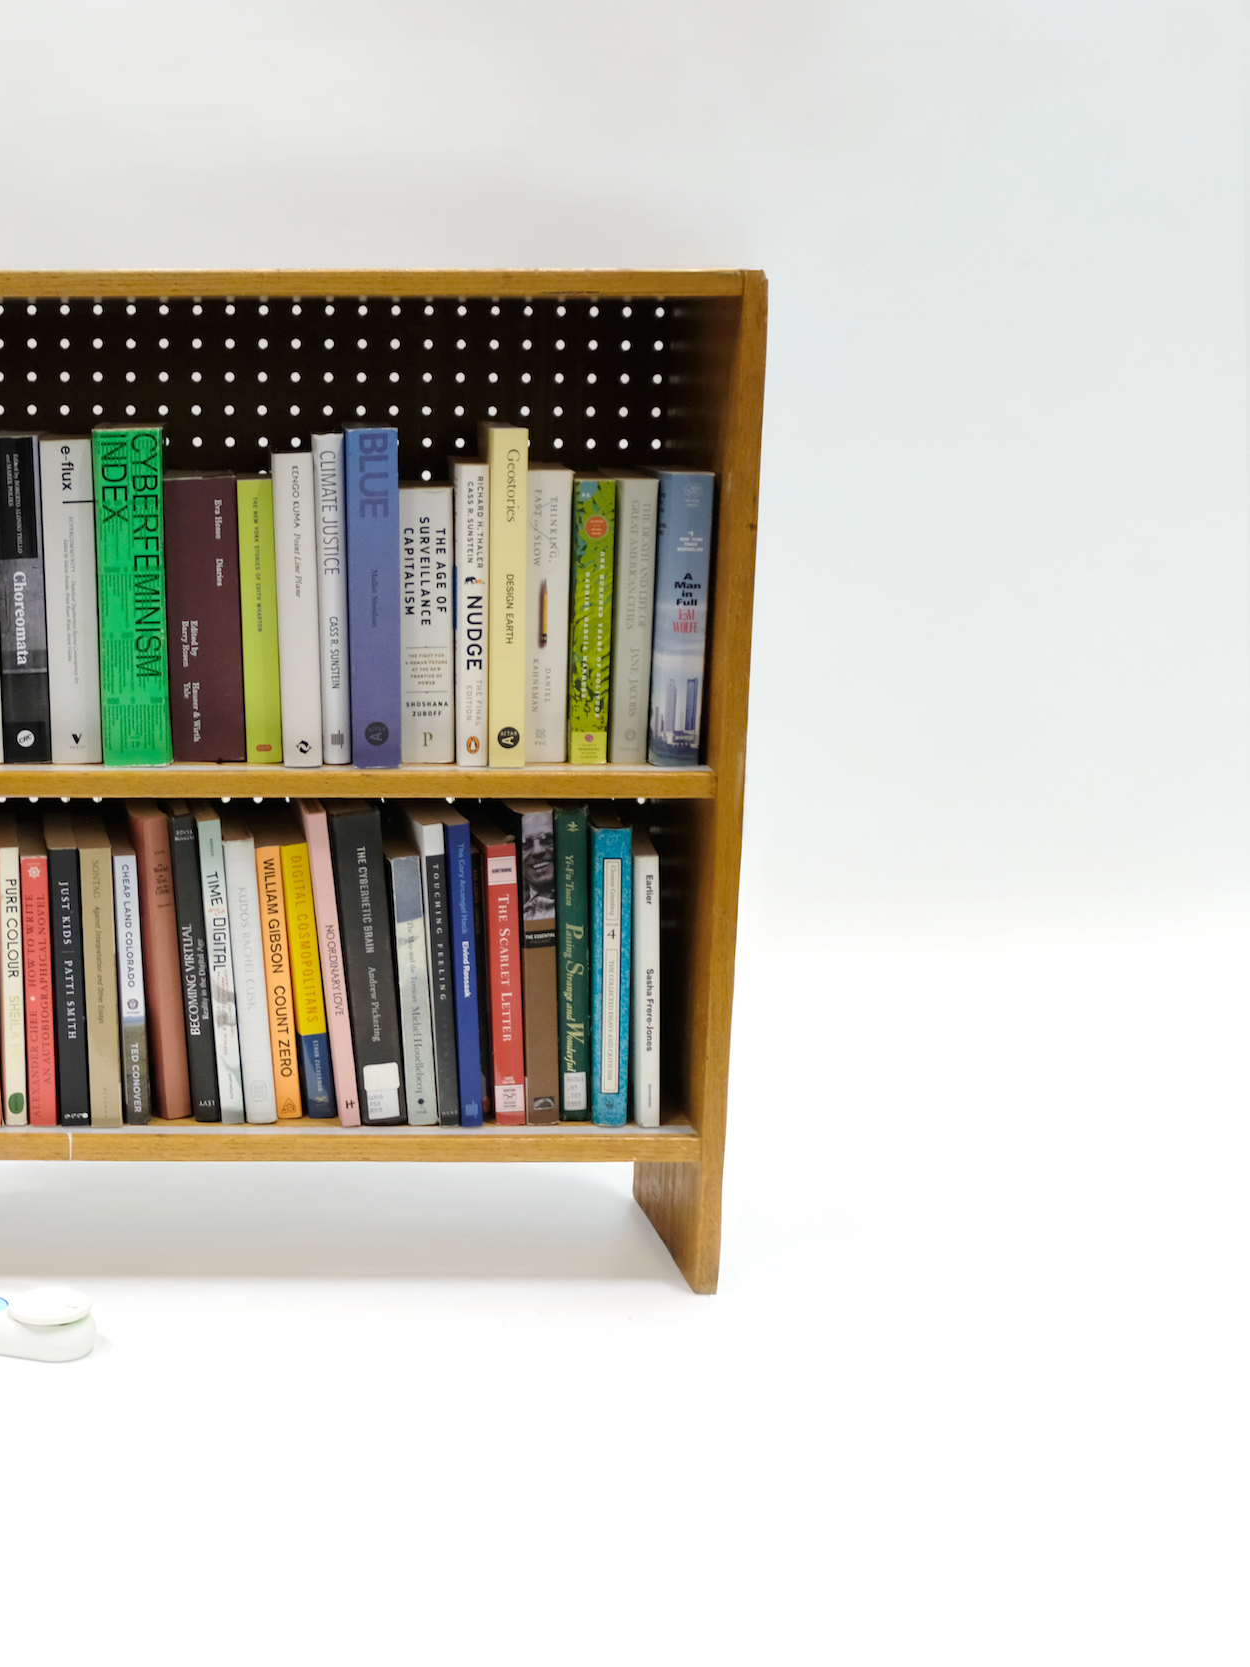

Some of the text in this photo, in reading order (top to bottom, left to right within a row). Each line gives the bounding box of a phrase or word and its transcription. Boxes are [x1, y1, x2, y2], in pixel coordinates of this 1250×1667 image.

[61, 445, 74, 491] e-flux
[100, 433, 128, 524] INDEX
[291, 465, 300, 498] KENGO
[359, 433, 389, 518] BLUE
[506, 448, 520, 523] Geostories
[214, 499, 223, 540] Eva Hesse
[292, 501, 301, 529] KUMA
[293, 533, 301, 554] Point
[319, 450, 340, 575] CLIMATE JUSTICE
[467, 508, 474, 516] R.
[477, 521, 483, 530] H.
[132, 433, 162, 677] CYBERFEMINISM
[215, 558, 224, 586] Diaries
[294, 556, 302, 573] Line
[404, 527, 415, 616] CAPITALISM
[419, 516, 431, 626] SURVEILLANCE
[436, 528, 447, 613] THE AGE OF
[626, 500, 640, 630] GREAT AMERICAN CITIES
[675, 581, 701, 589] Man
[12, 571, 29, 666] Choreomata
[505, 574, 514, 644] DESIGN EARTH
[598, 574, 606, 618] HUNDRED
[676, 598, 698, 606] Full
[181, 620, 190, 667] Barry Rosen
[190, 620, 199, 657] Edited by
[329, 616, 341, 689] CASS R. SUNSTEIN
[466, 596, 483, 670] NUDGE
[596, 657, 602, 668] OF
[183, 682, 191, 699] Yale
[192, 682, 200, 709] Hauser
[531, 658, 539, 713] KAHNEMAN
[594, 673, 602, 718] SOLITUDE
[628, 647, 640, 717] JANE JACOBS
[193, 719, 201, 742] Wirth
[206, 871, 223, 906] TIME
[356, 846, 375, 953] THE CYBERNETIC BRAIN
[458, 859, 466, 877] Cory
[459, 879, 468, 913] Arcangel
[565, 855, 574, 907] Yi-Fu Tuan
[645, 874, 654, 905] Earlier
[5, 879, 19, 978] PURE COLOUR
[58, 881, 77, 1039] JUST KIDS PATTI SMITH
[121, 864, 135, 988] CHEAP LAND COLORADO
[213, 917, 227, 972] DIGITAL
[238, 887, 257, 1010] KUDOS RACHEL CUSK
[291, 855, 318, 1023] DIGITAL COSMOPOLITANS
[433, 863, 447, 1001] TOUCHING FEELING
[37, 894, 51, 1084] AN AUTOBIOGRAPHICAL NOVEL
[181, 923, 201, 1035] BECOMING VIRTUAL
[263, 858, 292, 1078] WILLIAM GIBSON COUNT ZERO
[325, 925, 344, 1016] NO ORDINARY LOVE
[498, 893, 513, 1042] THE SCARLET LETTER
[563, 922, 585, 1073] Passing Strange and Wonderful
[25, 894, 41, 1118] ALEXANDER CHEE HOW TO WRITE
[367, 966, 381, 1042] Andrew Pickering
[646, 968, 654, 1052] Sasha Frere-Jones
[130, 1043, 142, 1113] TED CONOVER
[411, 1006, 424, 1093] Michel Houellebecq
